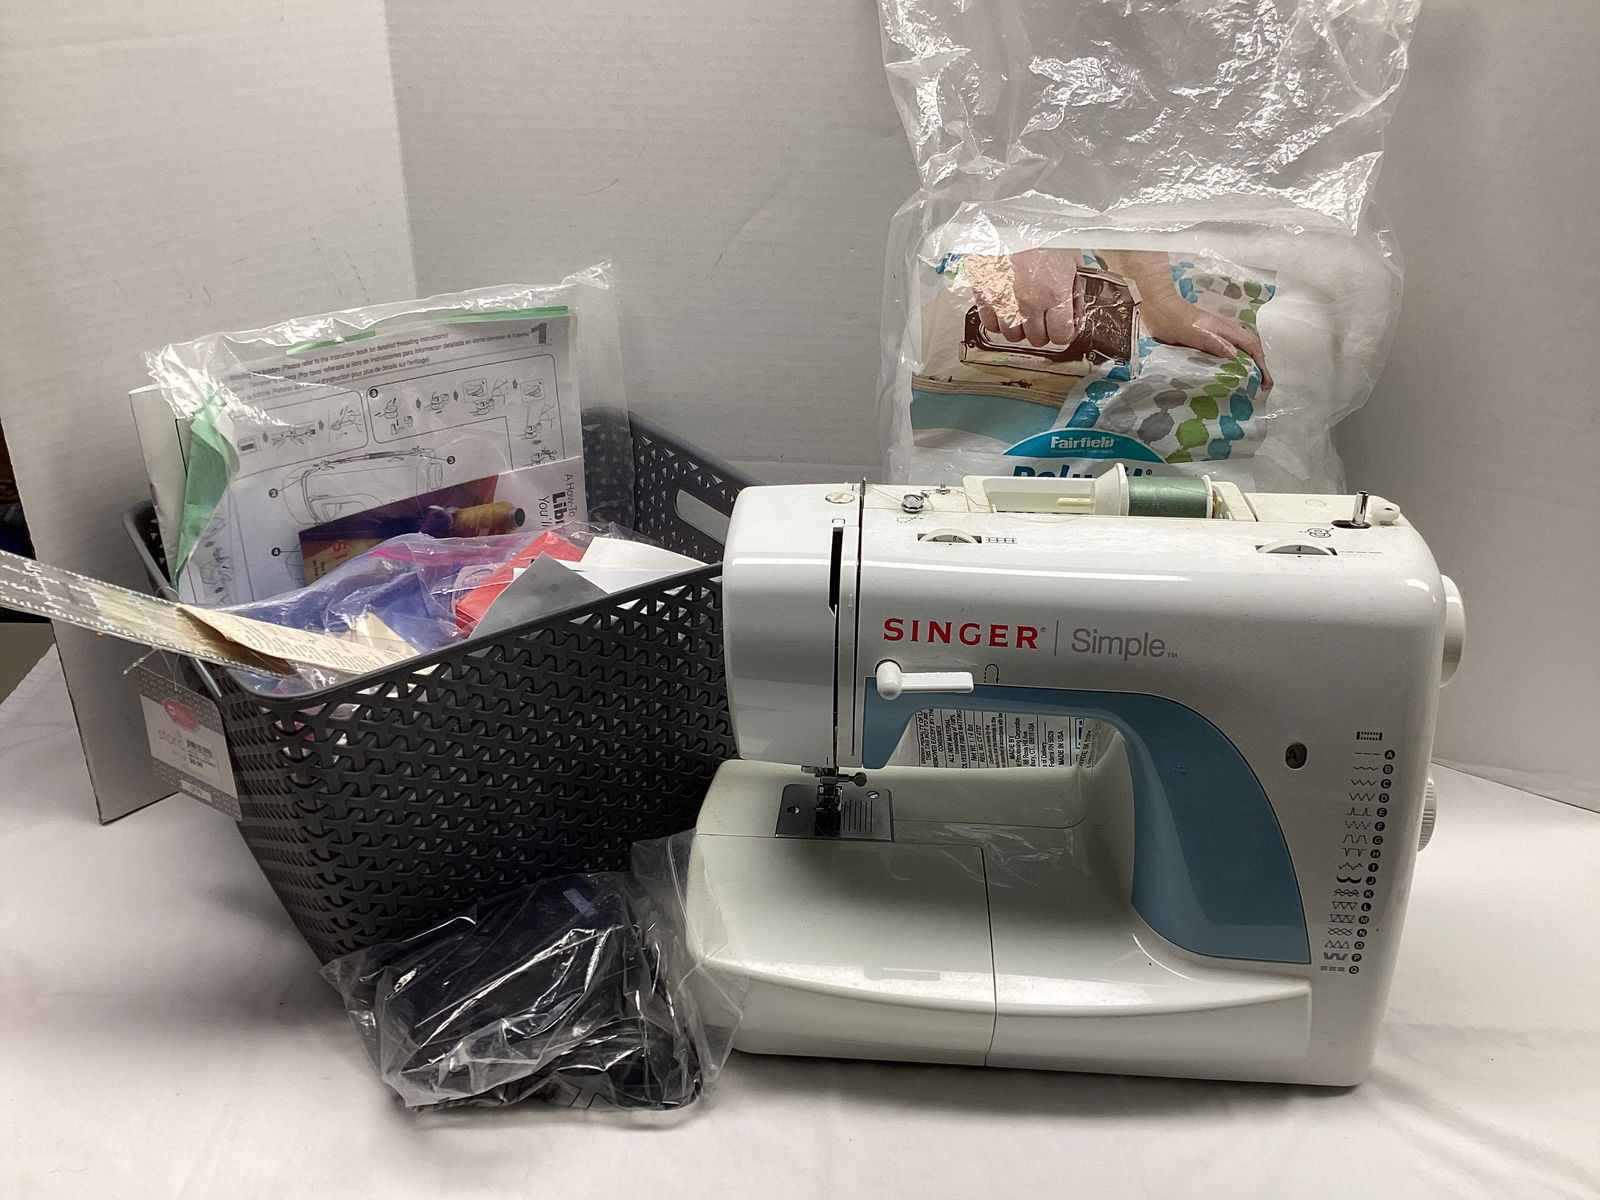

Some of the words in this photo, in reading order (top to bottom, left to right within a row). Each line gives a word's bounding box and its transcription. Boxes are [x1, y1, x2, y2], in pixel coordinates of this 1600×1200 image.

[531, 322, 548, 344] 1
[1050, 436, 1114, 448] Fairfield
[566, 483, 577, 518] How-To
[1008, 735, 1014, 743] BY
